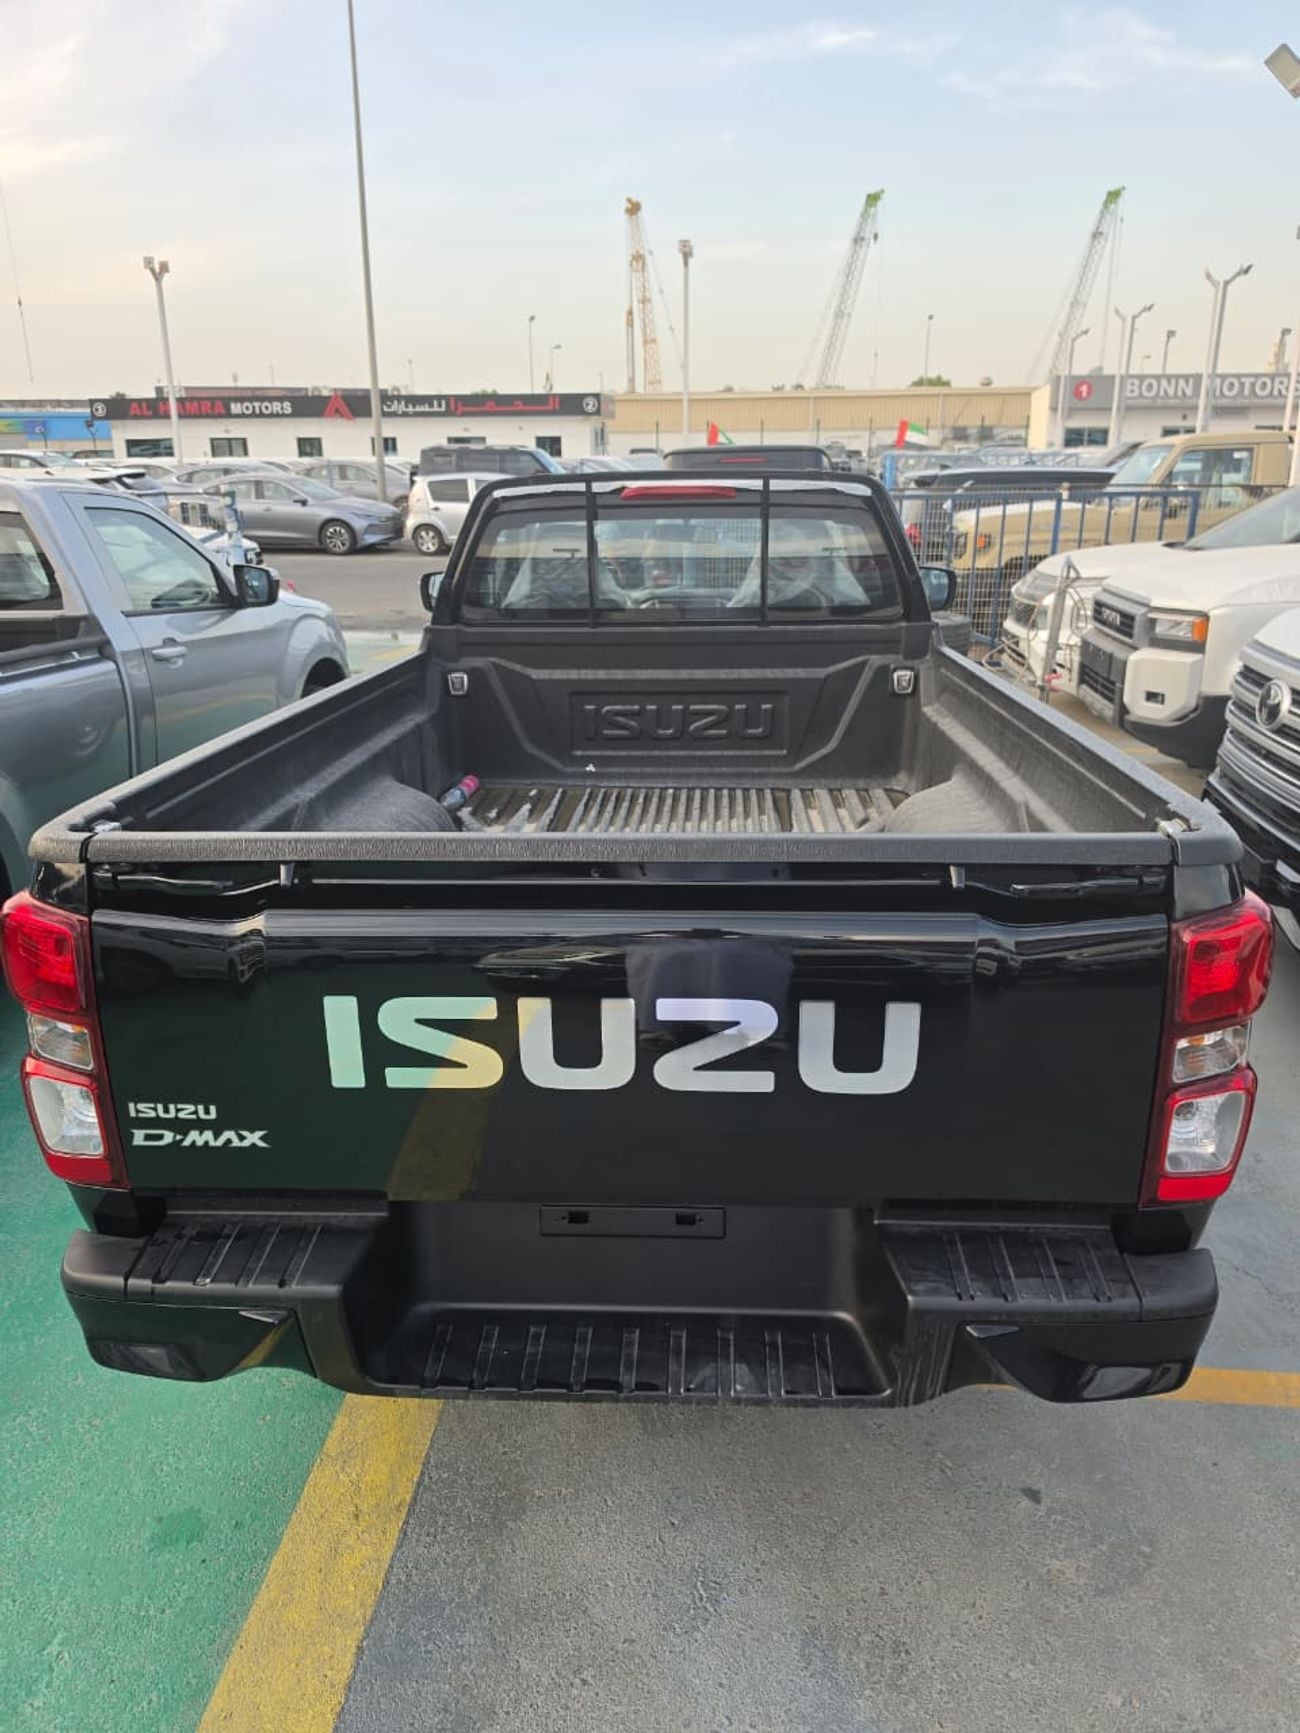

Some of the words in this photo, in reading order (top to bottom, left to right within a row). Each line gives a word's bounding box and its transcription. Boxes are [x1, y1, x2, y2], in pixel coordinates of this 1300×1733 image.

[1125, 378, 1194, 398] BONN
[129, 401, 152, 416] AL
[158, 400, 226, 416] HAMRA
[230, 401, 292, 415] MOTORS
[383, 399, 446, 415] للسيارات
[584, 704, 773, 740] ISUZU
[323, 995, 922, 1095] ISUZU
[128, 1102, 217, 1120] ISUZU
